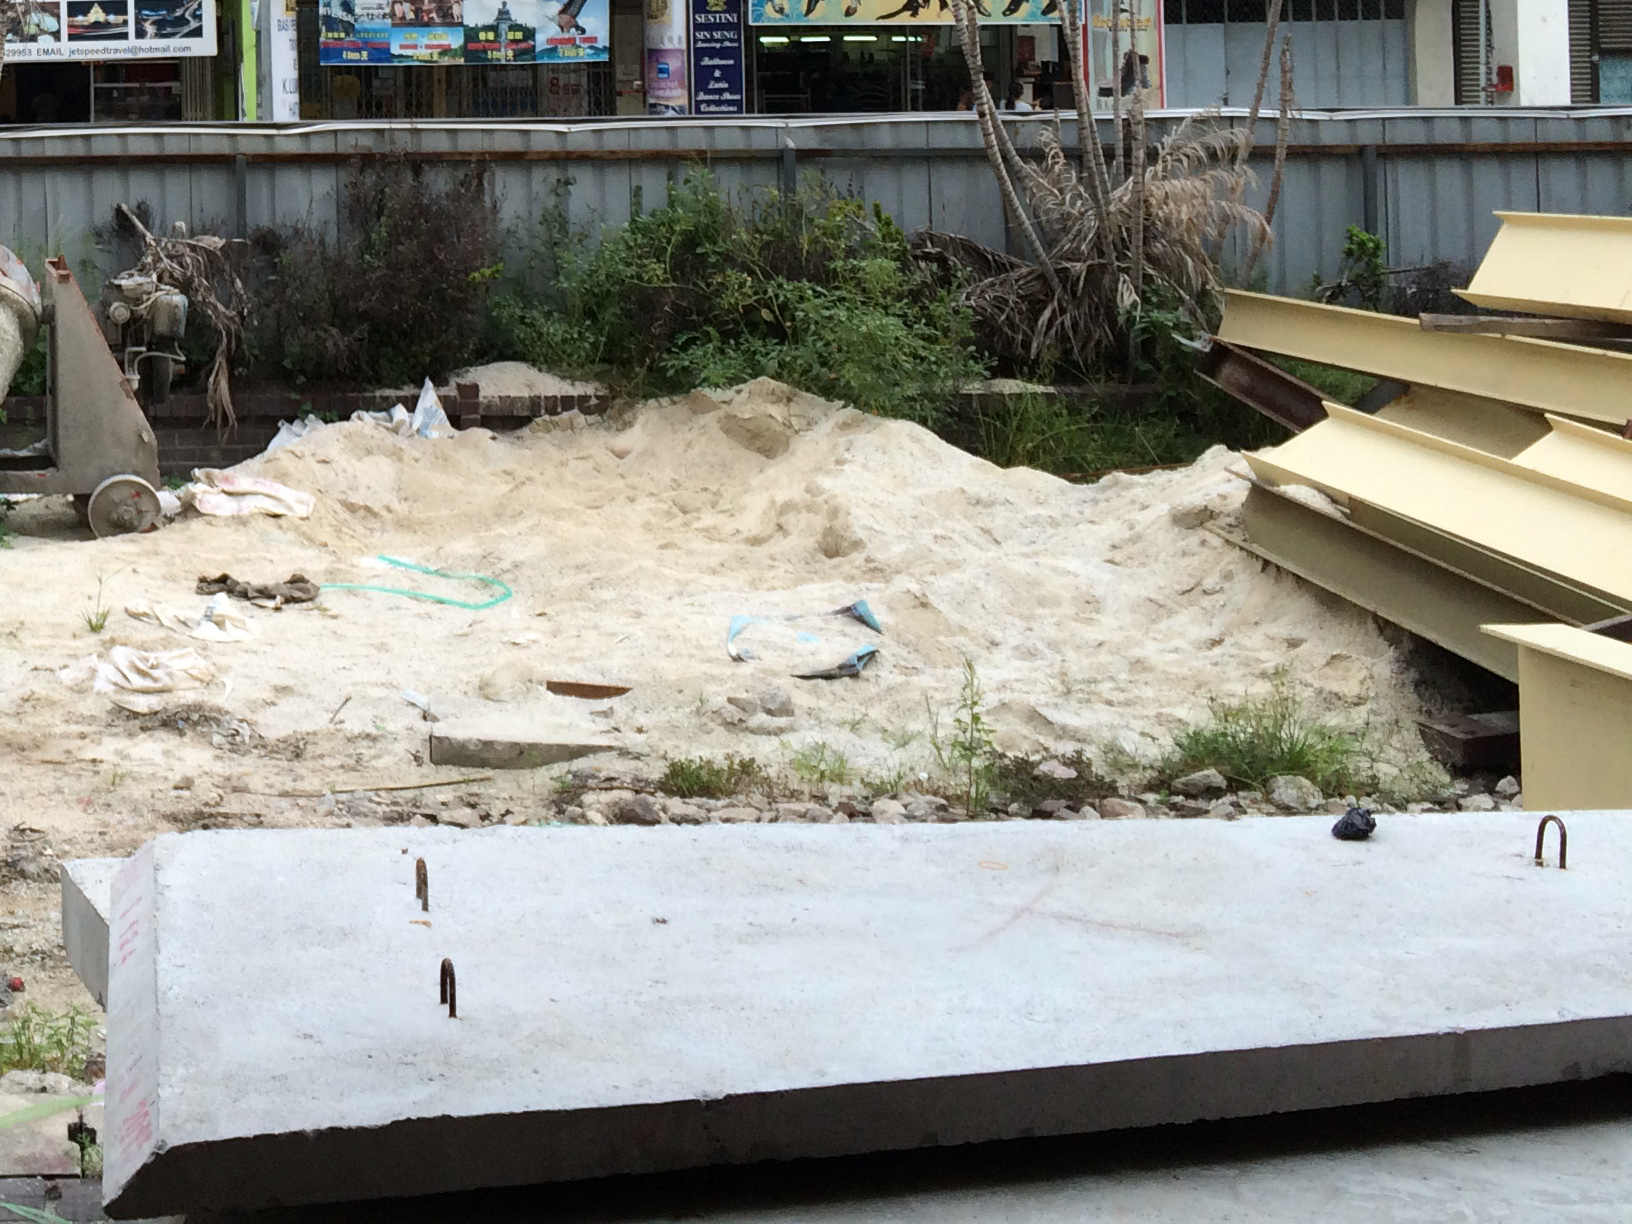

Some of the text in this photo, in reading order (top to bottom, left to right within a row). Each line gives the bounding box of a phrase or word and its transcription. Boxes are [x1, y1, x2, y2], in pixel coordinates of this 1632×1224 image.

[694, 13, 738, 24] SESTINI
[695, 30, 711, 40] SIN
[68, 45, 192, 57] jetspeedtravel@hotmail.com
[713, 69, 722, 78] &
